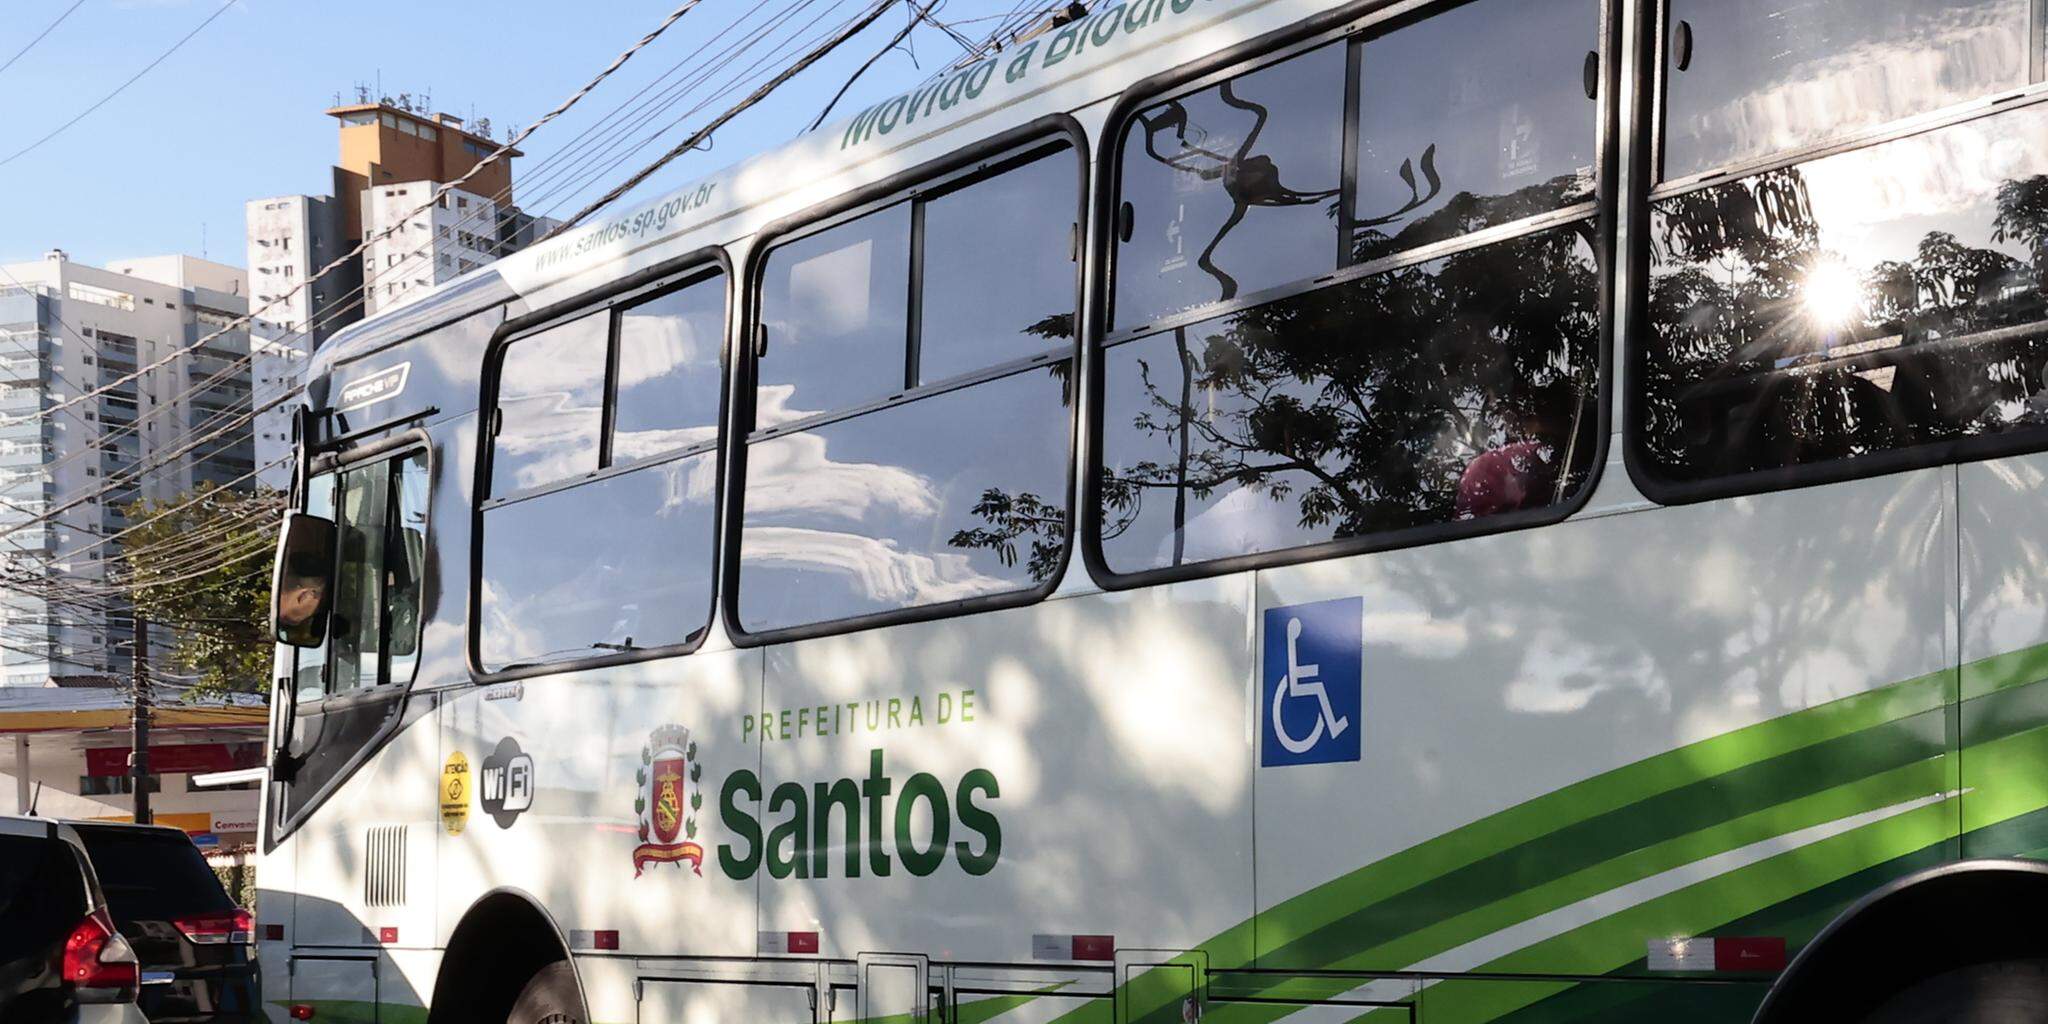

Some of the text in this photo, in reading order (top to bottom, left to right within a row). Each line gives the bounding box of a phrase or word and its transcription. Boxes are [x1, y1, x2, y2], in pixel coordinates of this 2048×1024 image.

[1006, 41, 1039, 83] a
[536, 183, 716, 272] www.santos.sp.gov.br
[743, 690, 976, 743] PREFEITURA DE
[717, 748, 1002, 881] Santos
